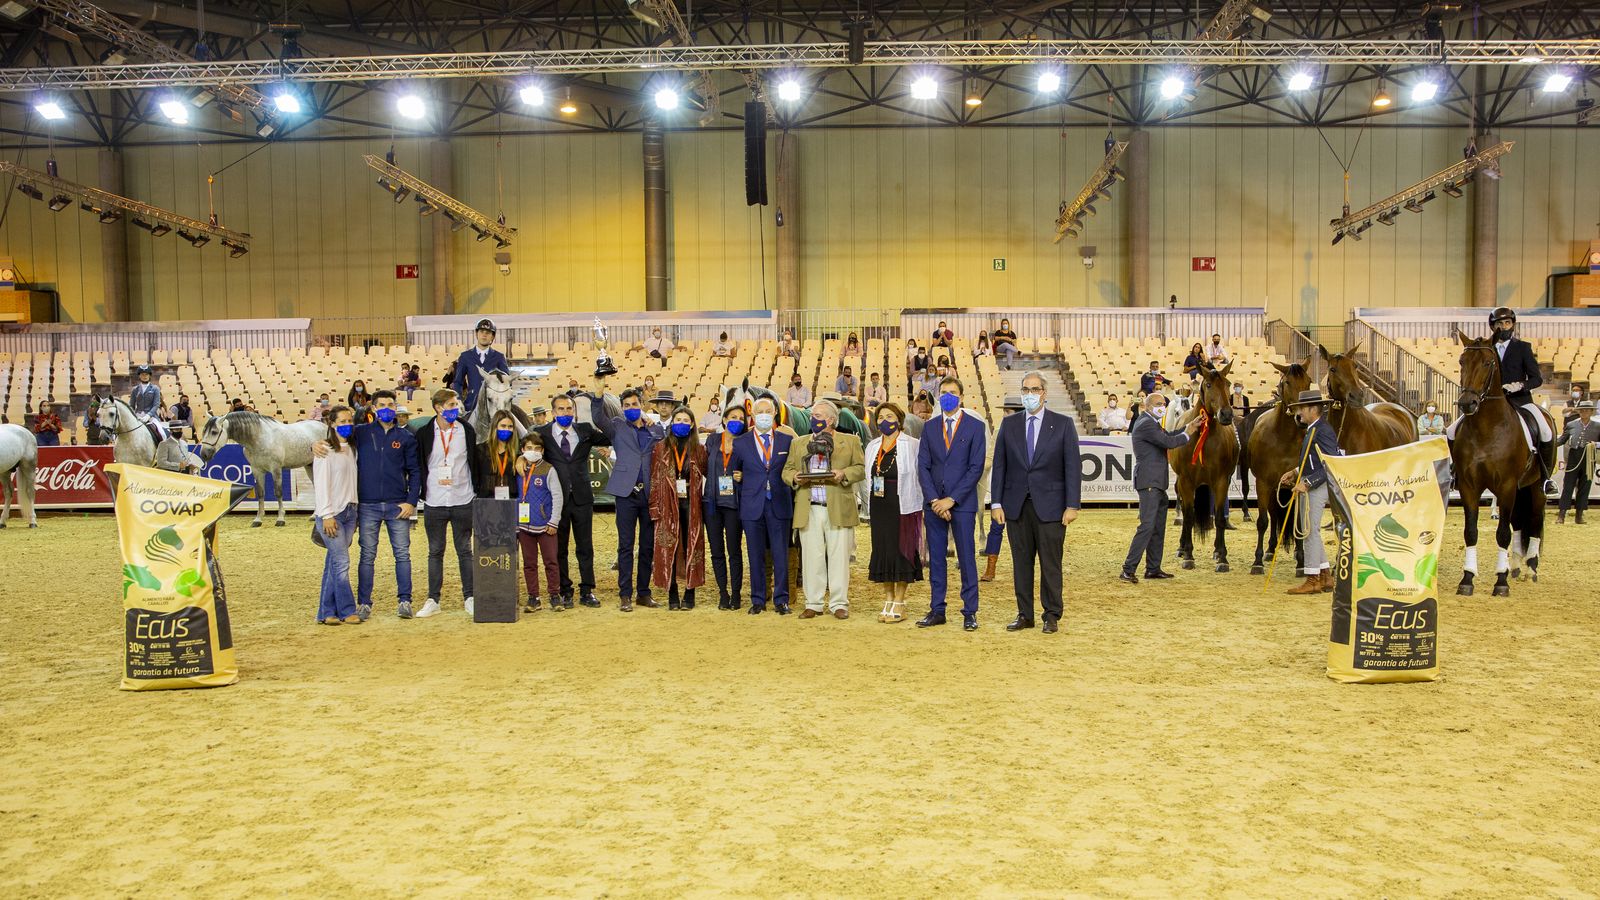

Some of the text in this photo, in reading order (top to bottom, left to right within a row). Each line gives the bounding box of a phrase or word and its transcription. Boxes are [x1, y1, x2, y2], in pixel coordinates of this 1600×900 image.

[208, 464, 256, 483] COP
[1098, 485, 1113, 493] PARA
[1354, 490, 1414, 506] COVAP
[140, 500, 203, 516] COVAP
[1340, 527, 1352, 580] COVAP
[1374, 604, 1428, 630] Ecus
[136, 614, 189, 639] Ecus
[174, 666, 200, 676] futuro
